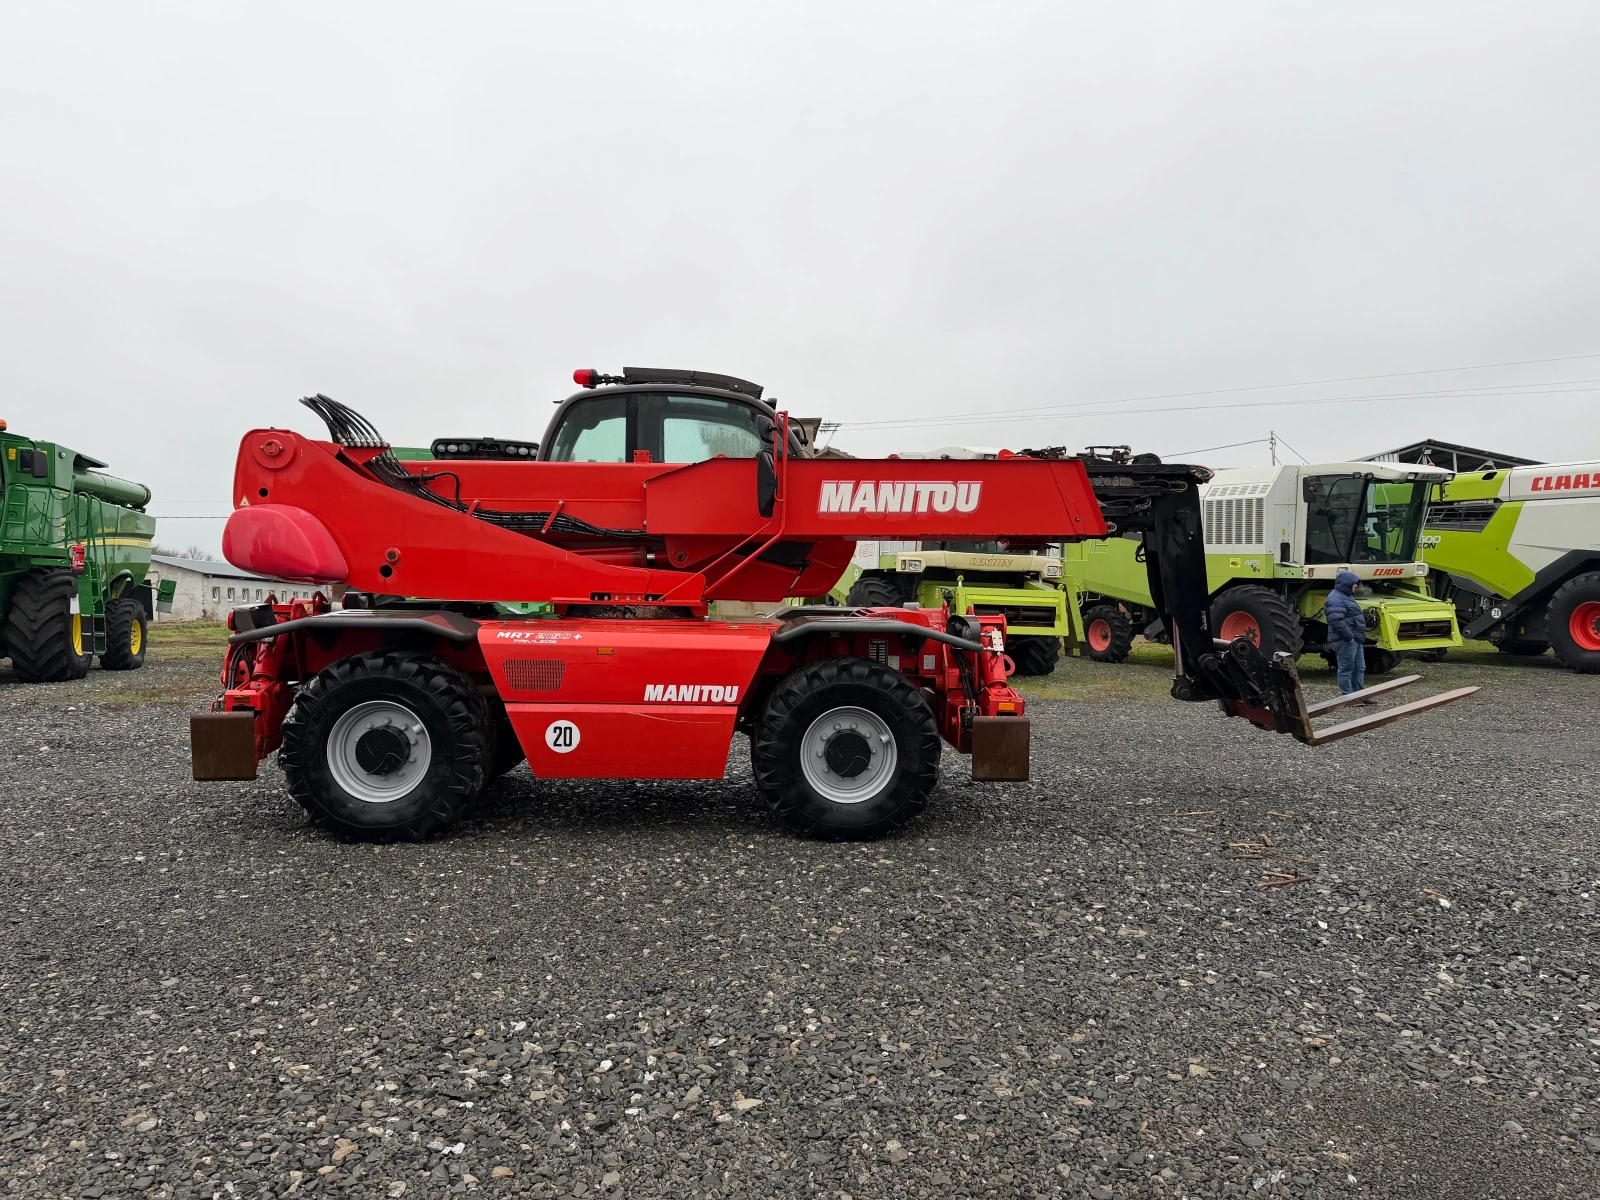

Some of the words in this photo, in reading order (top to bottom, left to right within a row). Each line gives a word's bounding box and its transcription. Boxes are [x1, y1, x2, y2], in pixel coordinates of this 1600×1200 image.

[1531, 473, 1600, 492] CLAAS
[817, 480, 983, 513] MANITOU
[969, 557, 1013, 568] LEXION
[1373, 568, 1404, 577] CLAAS
[496, 631, 534, 639] MRT
[643, 684, 739, 702] MANITOU
[553, 726, 573, 747] 20
